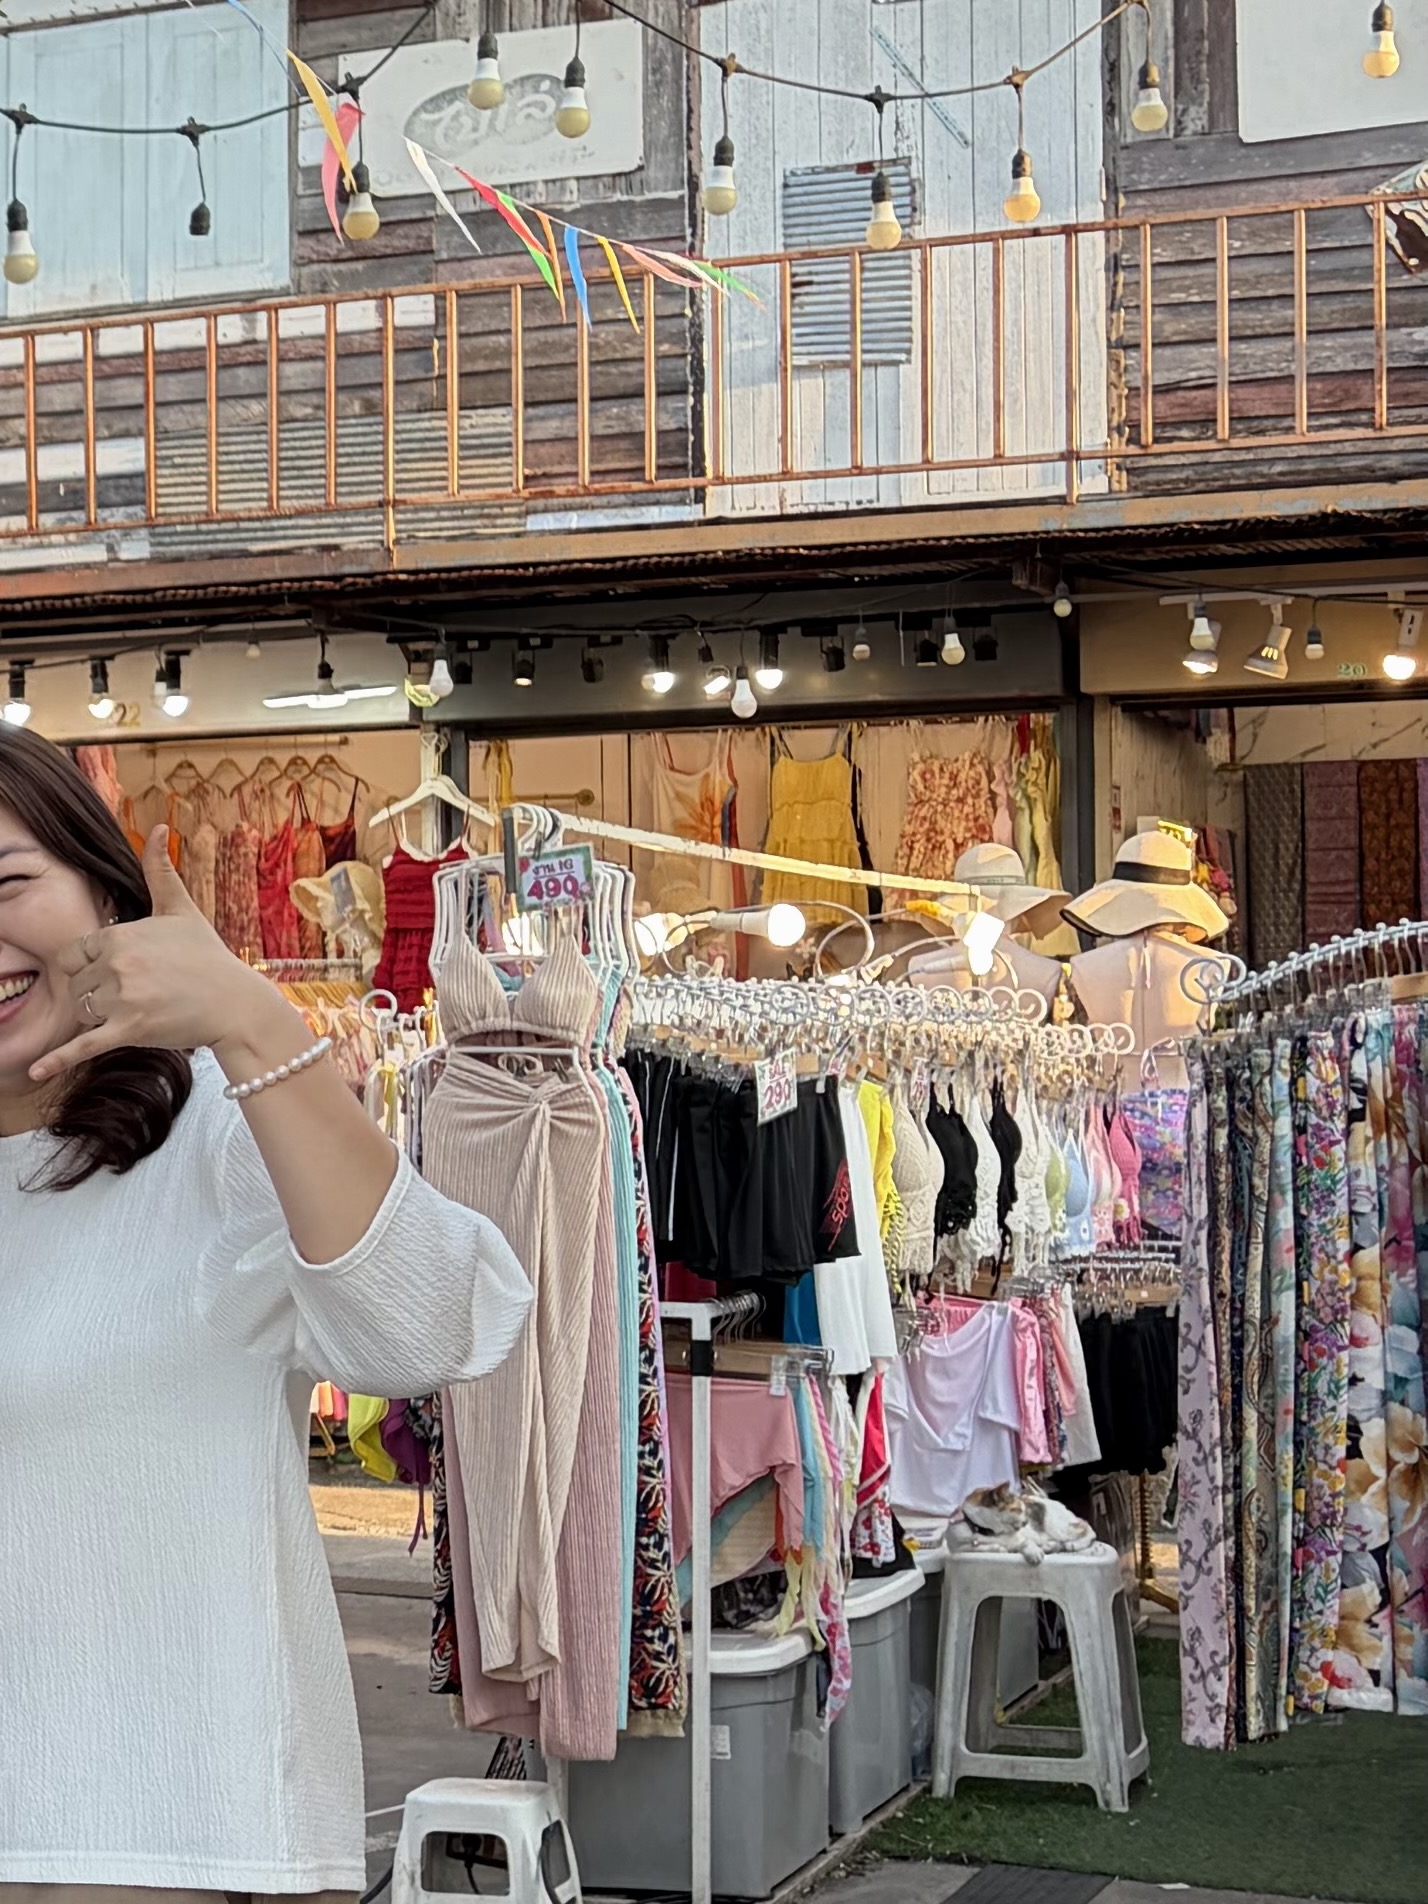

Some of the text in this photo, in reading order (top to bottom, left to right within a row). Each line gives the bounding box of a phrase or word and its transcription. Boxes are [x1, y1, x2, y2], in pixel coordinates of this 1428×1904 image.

[113, 702, 142, 729] 22
[527, 875, 579, 901] 490
[764, 1078, 792, 1110] 290
